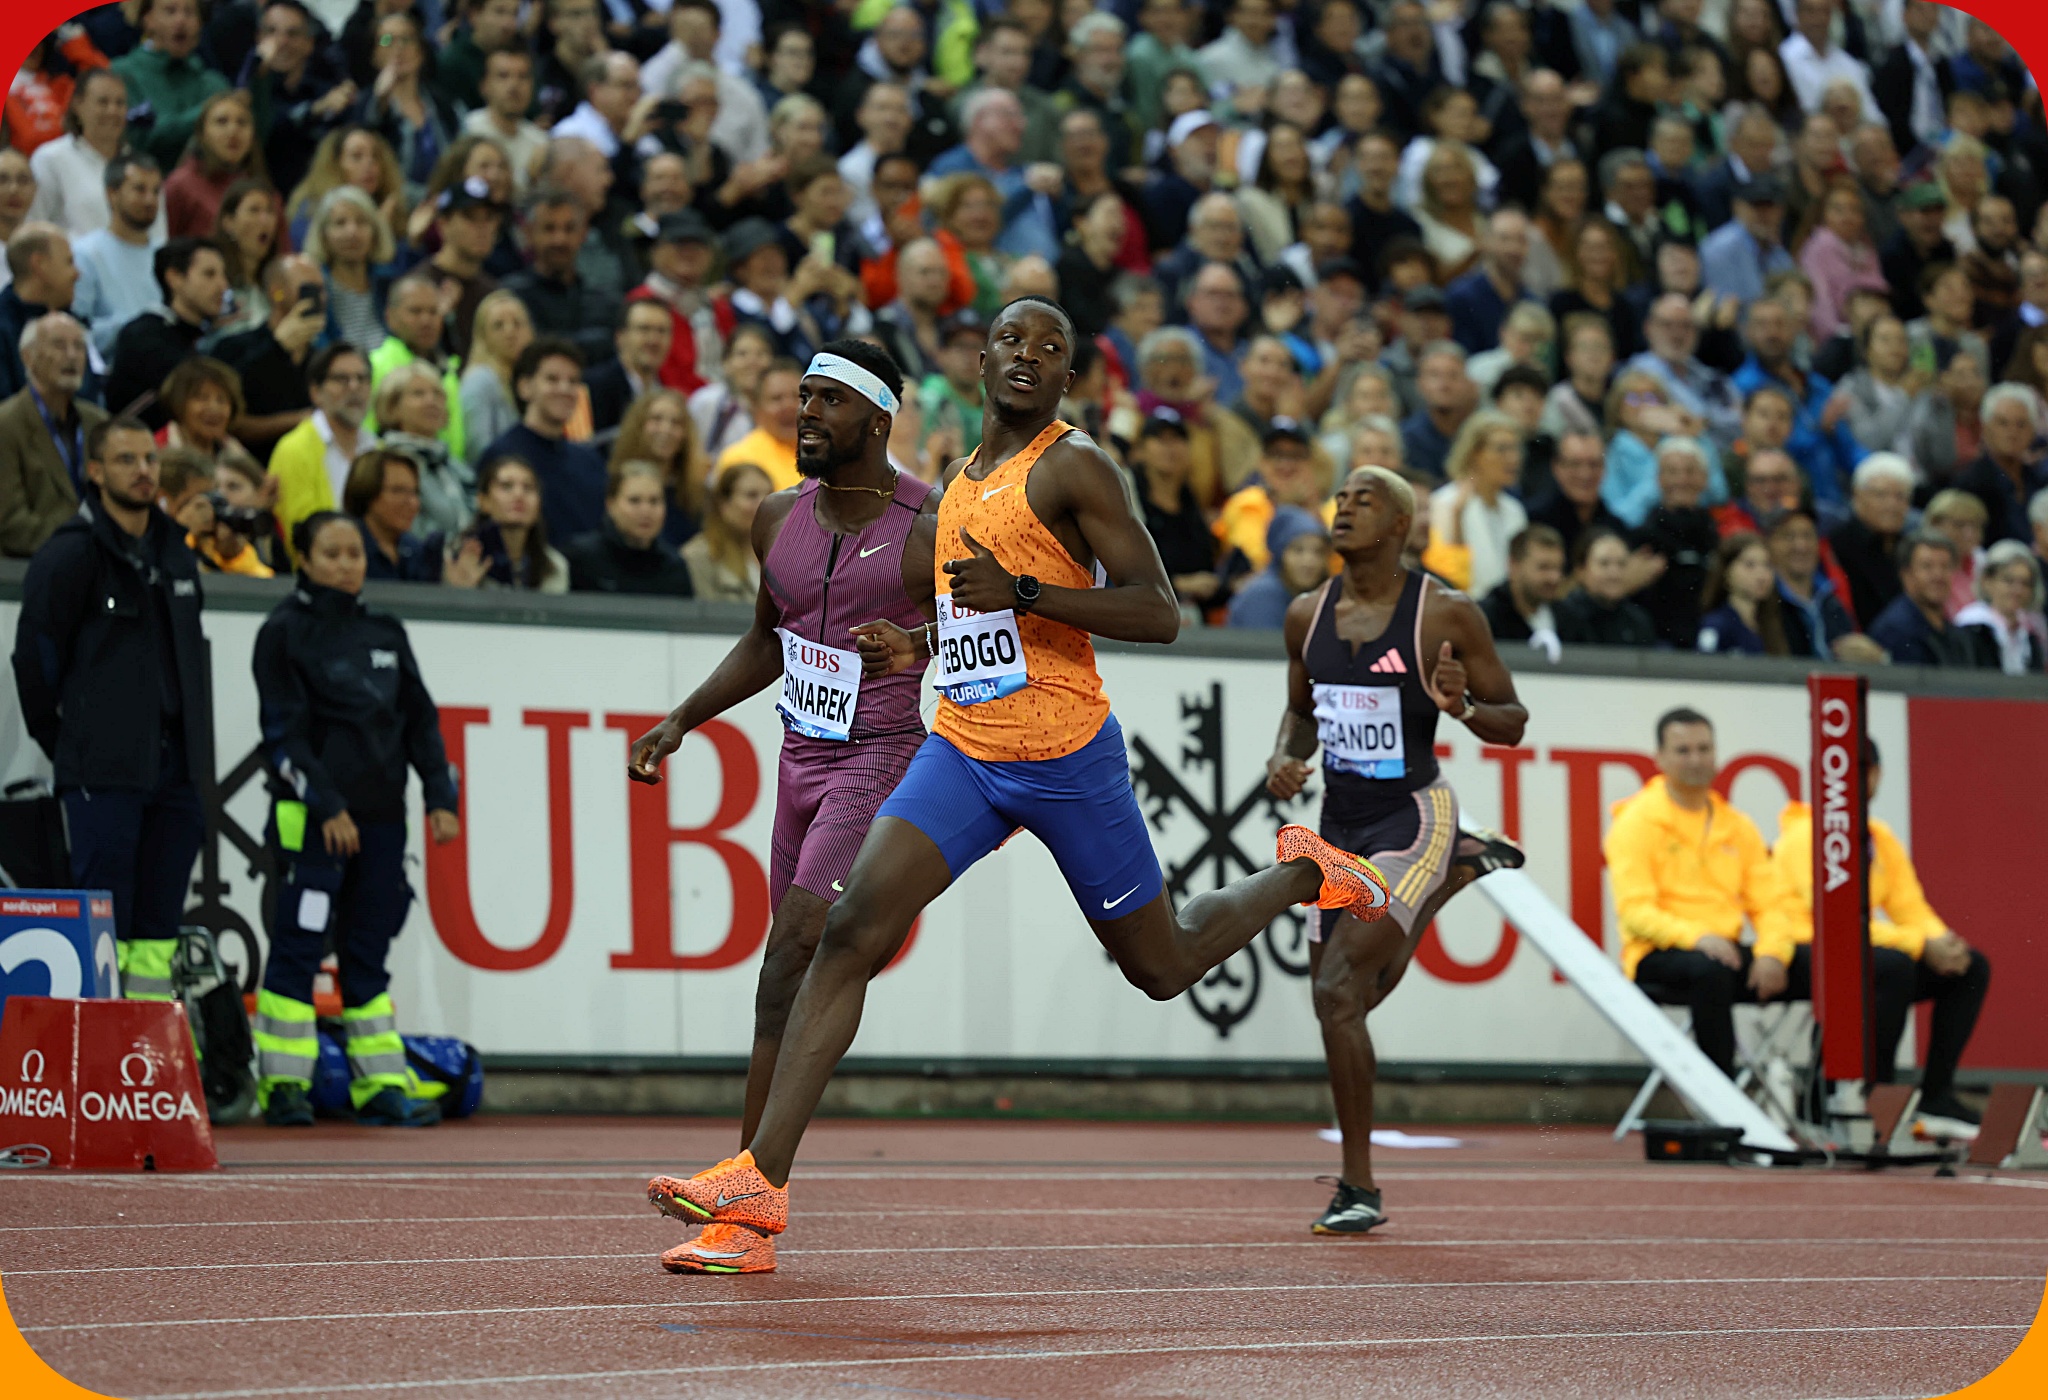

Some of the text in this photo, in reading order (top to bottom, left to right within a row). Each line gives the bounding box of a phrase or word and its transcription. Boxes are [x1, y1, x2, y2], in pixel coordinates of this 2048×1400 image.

[801, 644, 840, 673] UBS
[950, 682, 997, 703] ZURICH
[1342, 691, 1379, 711] UBS
[1822, 744, 1851, 893] OMEGA
[425, 706, 923, 972] UB
[80, 1091, 201, 1122] OMEGA
